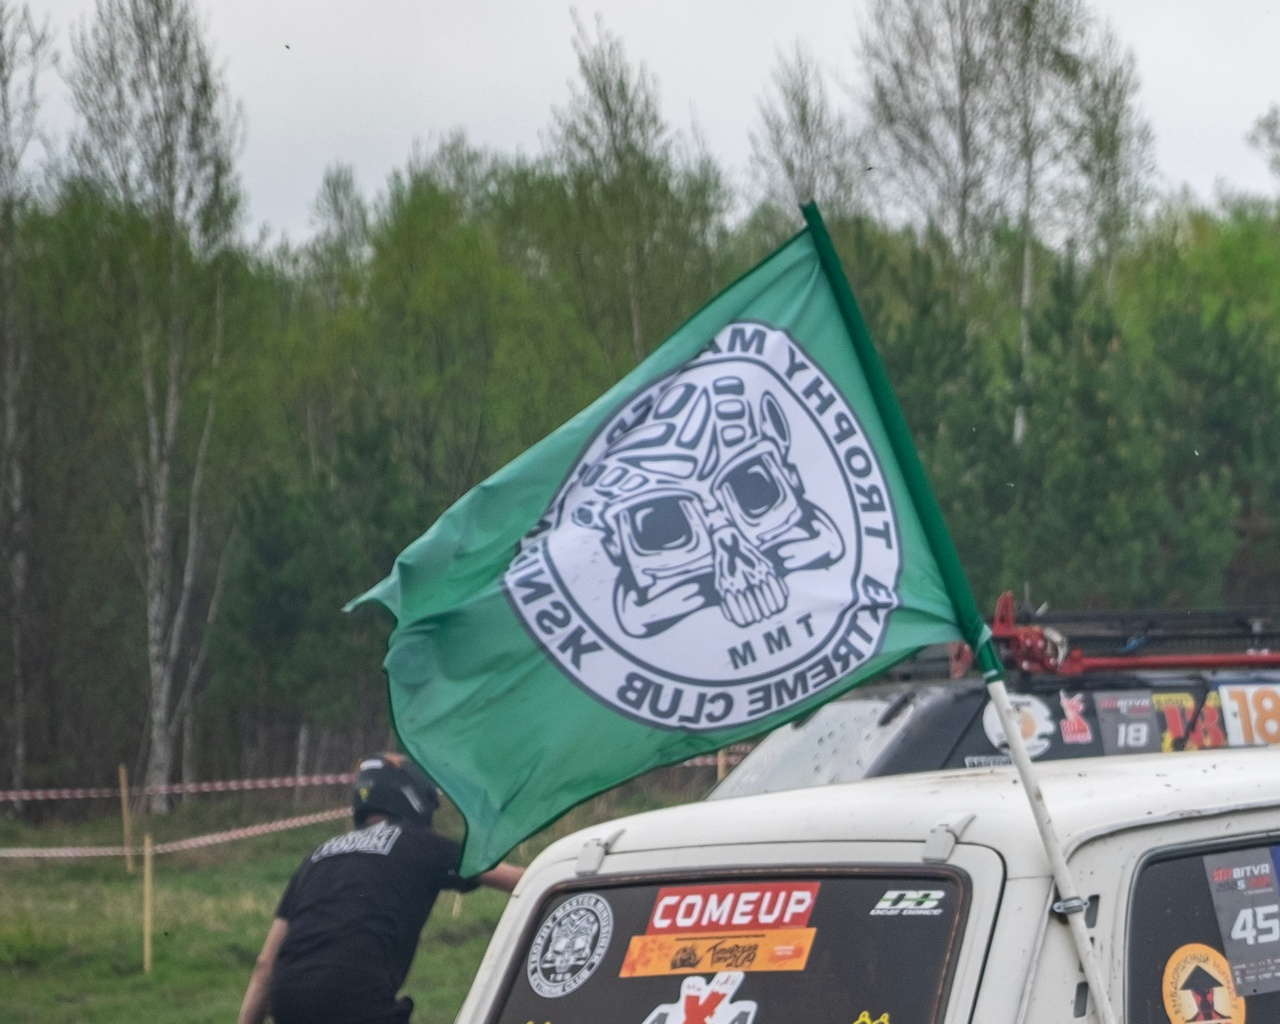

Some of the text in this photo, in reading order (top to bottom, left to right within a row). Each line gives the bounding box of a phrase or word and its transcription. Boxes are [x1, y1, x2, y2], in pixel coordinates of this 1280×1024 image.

[1117, 722, 1148, 748] 18
[652, 890, 813, 929] COMEUP
[1231, 904, 1280, 946] 45
